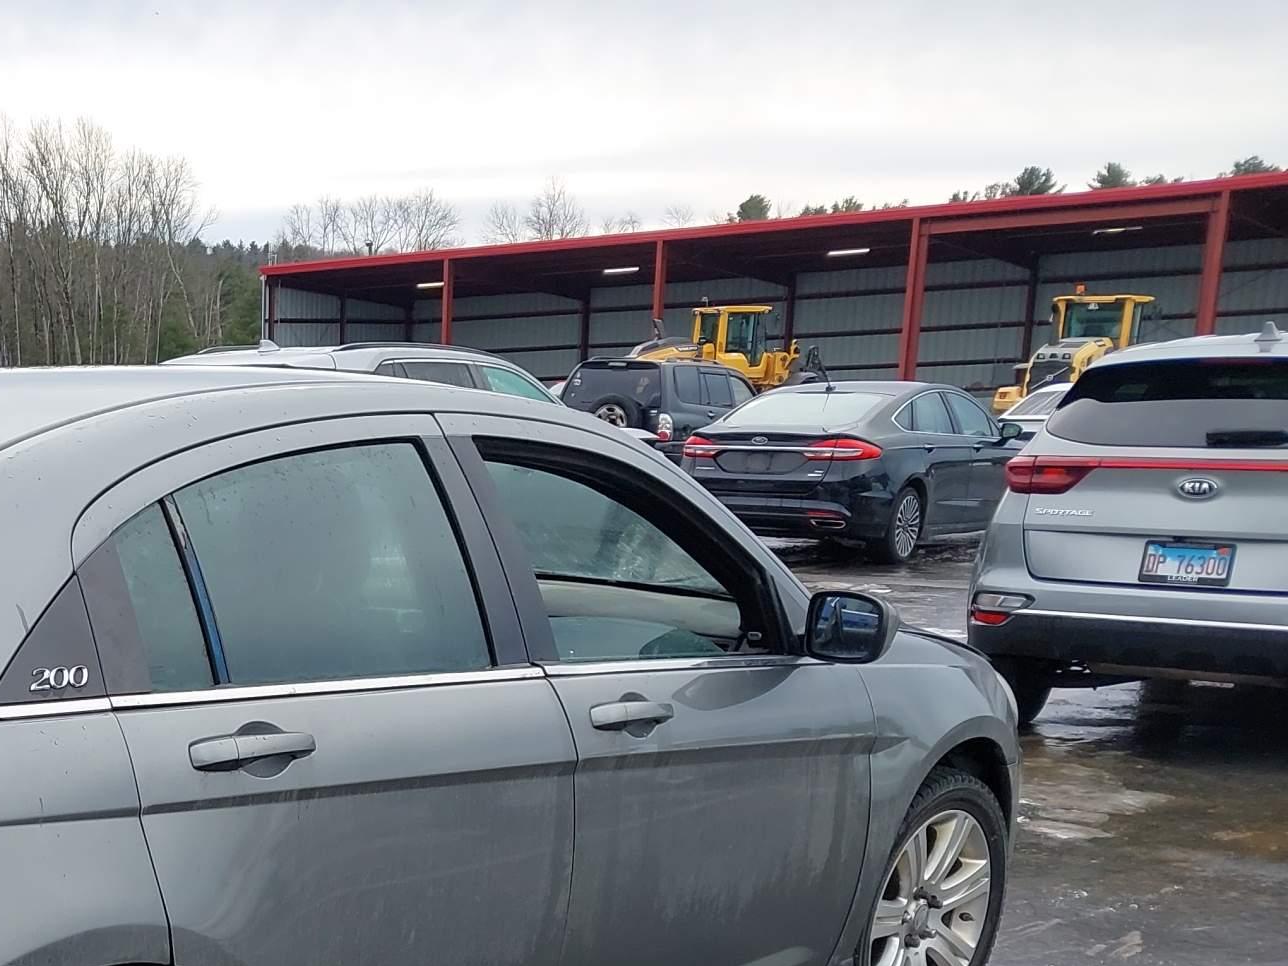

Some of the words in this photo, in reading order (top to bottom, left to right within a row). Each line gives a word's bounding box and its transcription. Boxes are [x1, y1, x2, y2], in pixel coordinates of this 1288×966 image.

[1183, 482, 1210, 493] KIA
[1144, 553, 1167, 574] DP
[1176, 554, 1228, 577] 76300
[29, 664, 89, 692] 200
